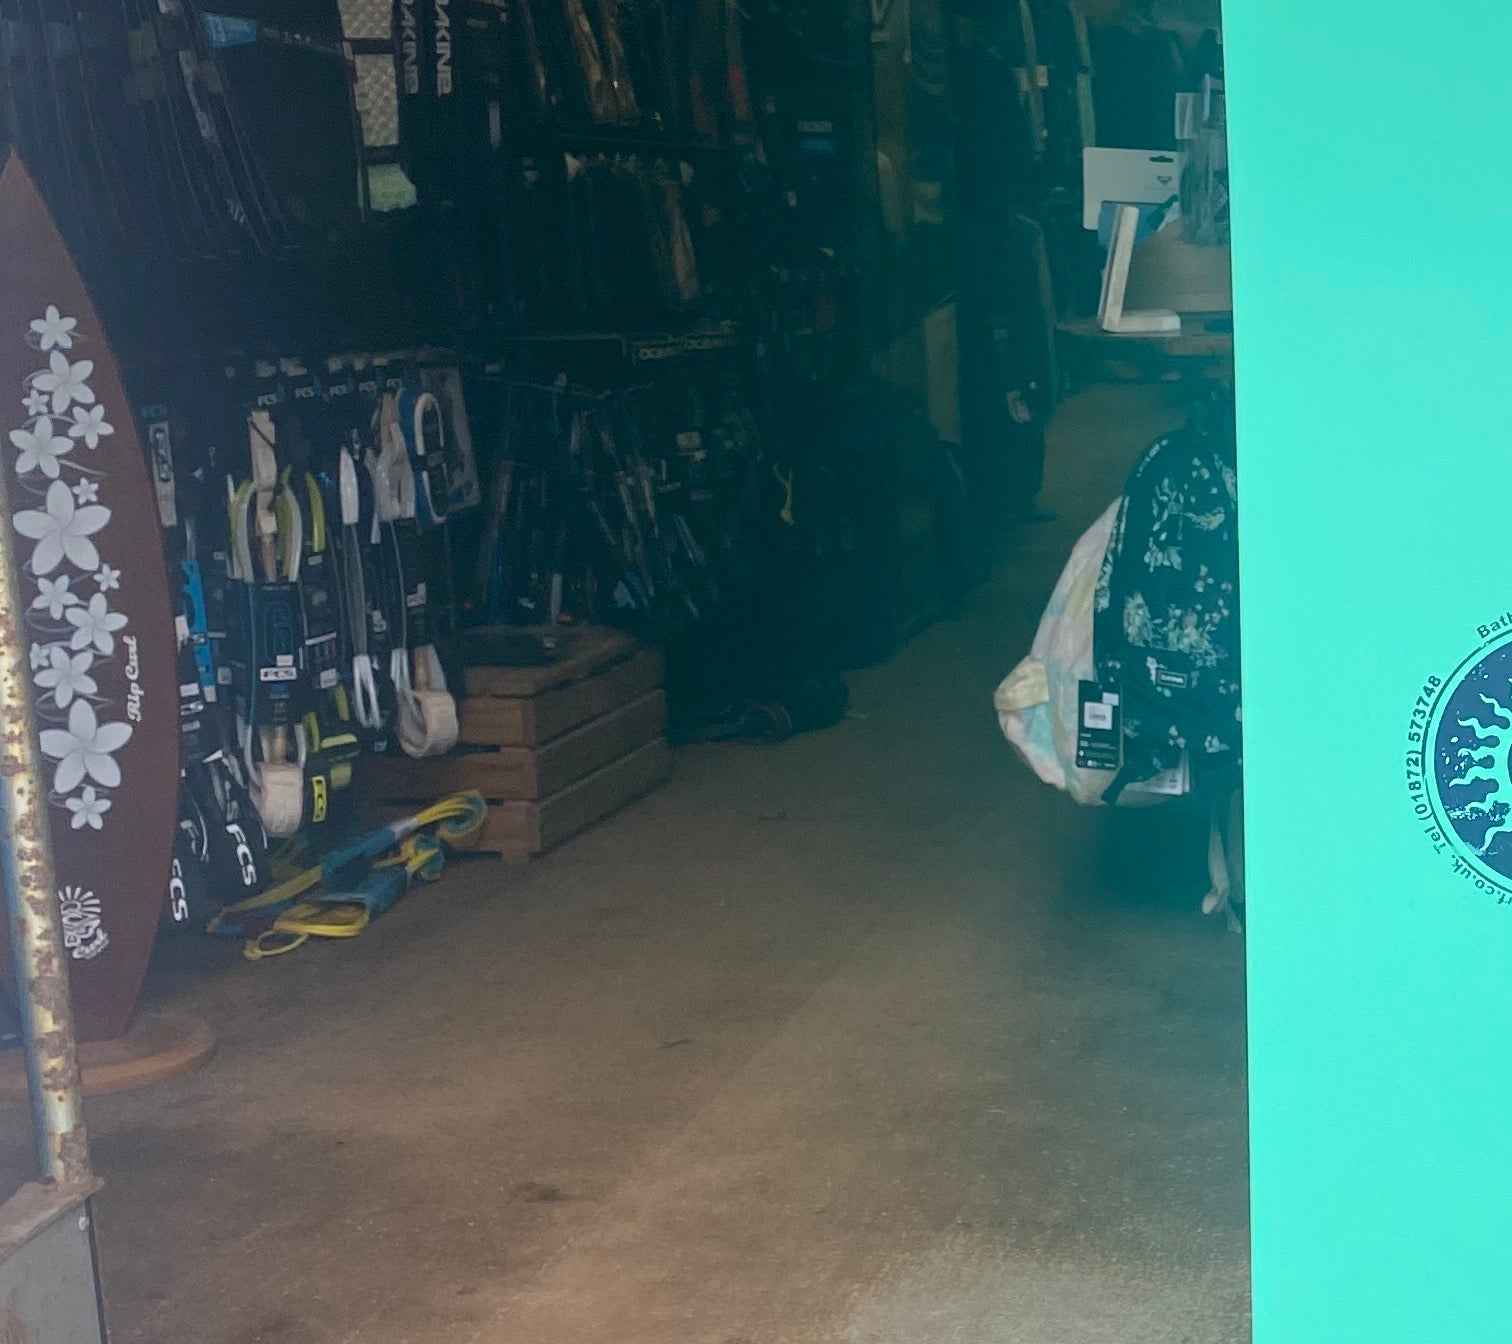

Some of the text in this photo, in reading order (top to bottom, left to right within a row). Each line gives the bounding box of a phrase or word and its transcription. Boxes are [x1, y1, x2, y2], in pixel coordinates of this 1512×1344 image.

[1408, 675, 1442, 743] 573748
[1406, 749, 1434, 822] (01872)
[226, 824, 257, 886] FCS
[1424, 825, 1447, 855] Tel
